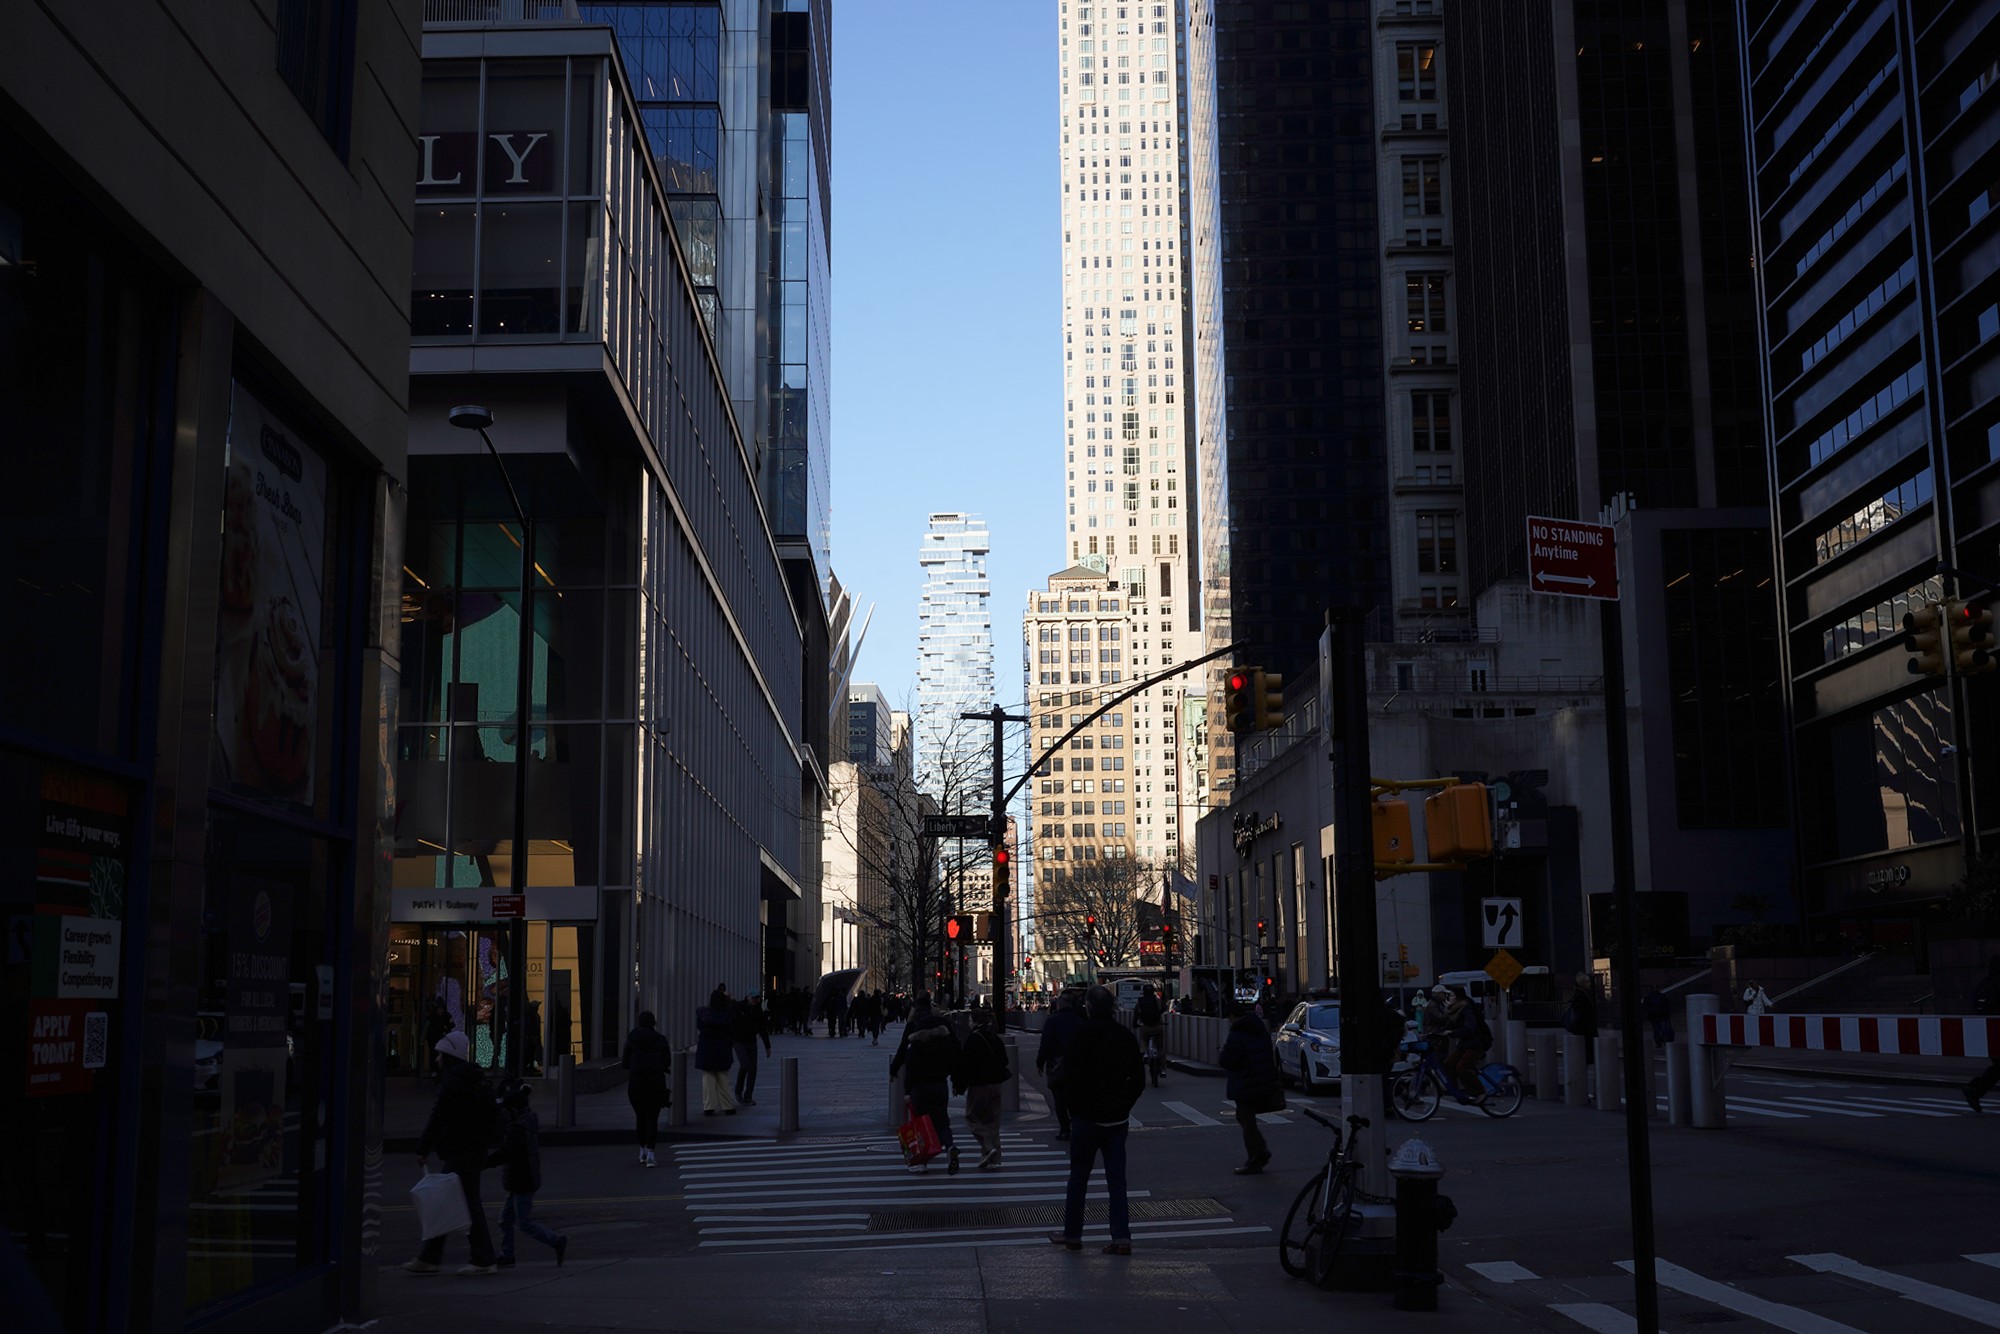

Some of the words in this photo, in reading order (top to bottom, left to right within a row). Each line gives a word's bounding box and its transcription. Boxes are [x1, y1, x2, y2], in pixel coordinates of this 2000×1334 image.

[416, 133, 548, 185] LY
[256, 471, 280, 509] Fresh
[1532, 525, 1548, 540] NO
[1550, 527, 1604, 546] STANDING
[1534, 543, 1579, 561] Anytime
[45, 814, 66, 835] Live
[66, 817, 81, 838] life
[81, 825, 103, 843] your
[103, 830, 121, 849] way.
[929, 819, 957, 834] Liberty
[412, 900, 435, 909] PATH
[445, 900, 480, 911] Subway
[64, 928, 88, 943] Career
[88, 931, 112, 947] growth
[63, 949, 96, 968] Flexibility
[232, 952, 250, 979] 15%
[250, 954, 288, 981] DISCOUNT
[62, 971, 102, 989] Competitive
[102, 975, 114, 990] pay
[33, 1014, 72, 1038] APPLY
[32, 1041, 76, 1065] TODAY!
